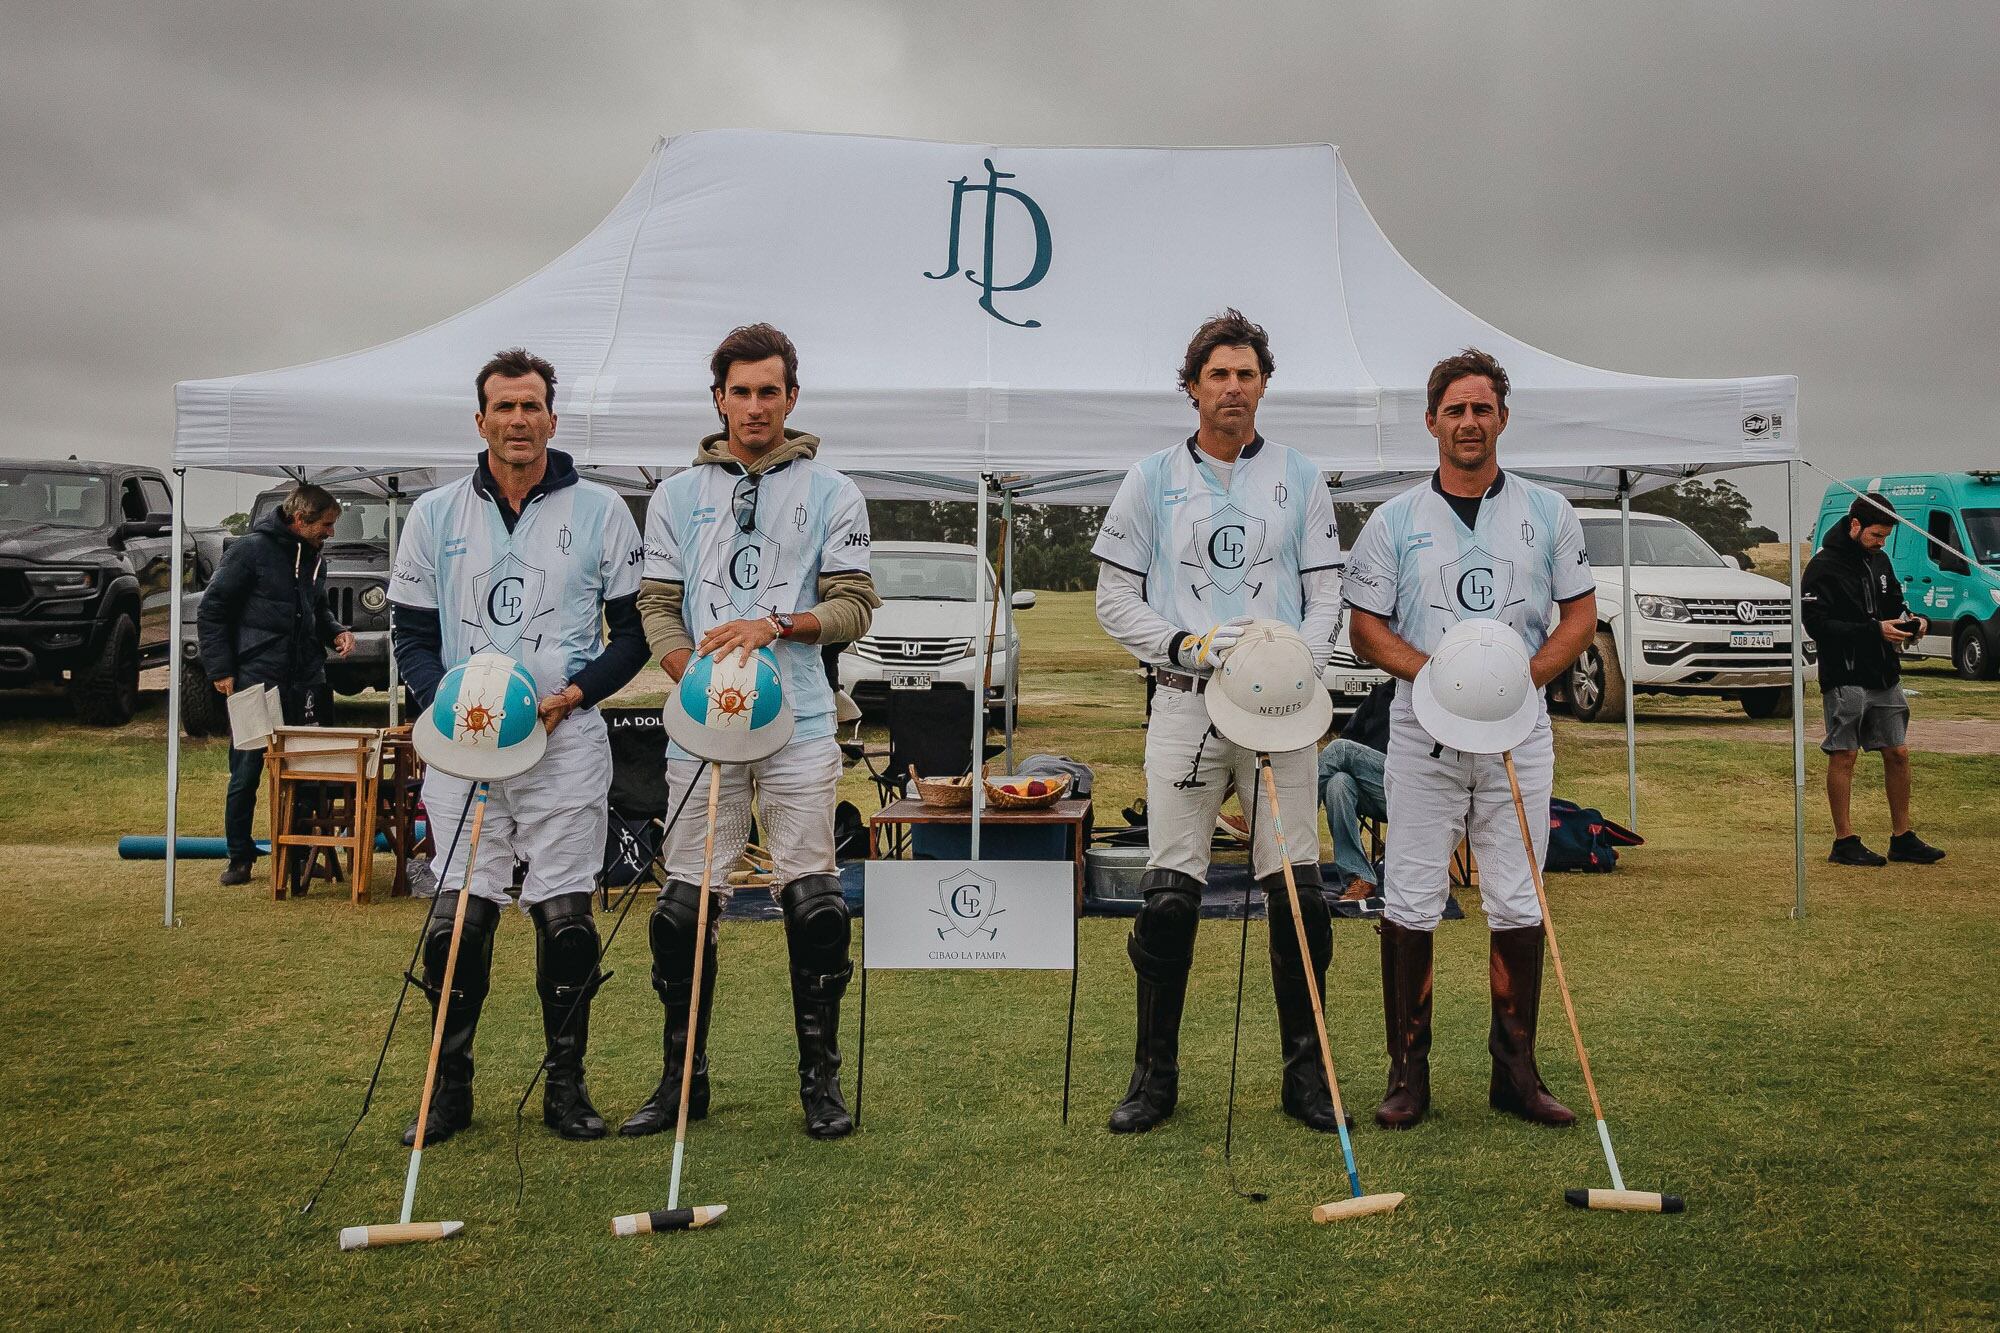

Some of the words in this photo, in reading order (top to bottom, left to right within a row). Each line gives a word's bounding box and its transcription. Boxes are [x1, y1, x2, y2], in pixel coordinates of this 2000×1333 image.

[913, 676, 930, 686] 345
[1259, 701, 1302, 716] NETJETS
[614, 717, 631, 727] LA
[928, 951, 959, 960] CIBAO
[961, 951, 973, 960] LA
[975, 951, 1007, 960] PAMPA
